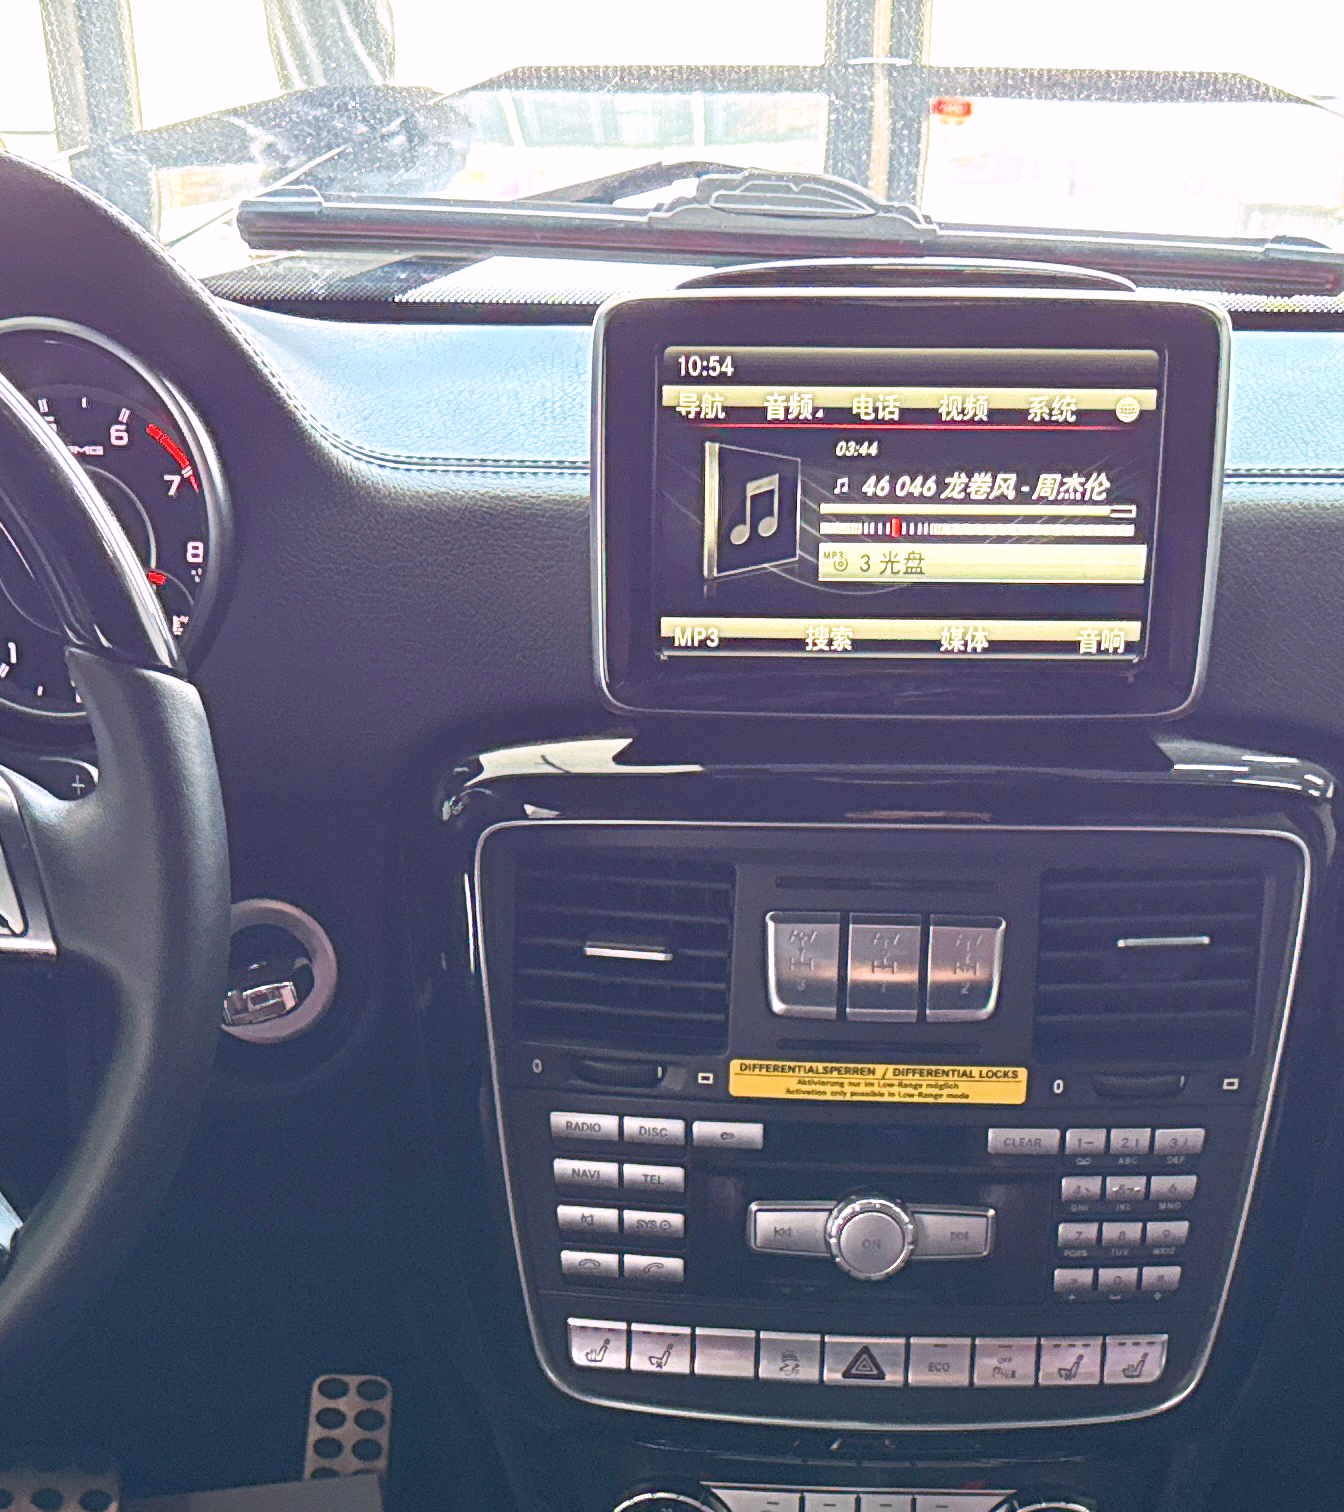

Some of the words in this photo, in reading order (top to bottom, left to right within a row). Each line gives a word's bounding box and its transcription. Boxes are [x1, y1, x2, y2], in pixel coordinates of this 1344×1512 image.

[676, 355, 734, 377] 10:54
[675, 391, 726, 421] 导航
[763, 391, 814, 421] 音频
[851, 392, 901, 422] 电话
[938, 394, 990, 422] 视频
[1027, 395, 1078, 423] 系统
[110, 425, 128, 445] 6
[835, 440, 879, 458] 03:44
[163, 474, 181, 496] 7
[861, 475, 891, 499] 46
[895, 474, 937, 499] 046
[940, 472, 1016, 500] 龙卷风
[1032, 472, 1111, 501] 周杰伦
[186, 542, 204, 563] 8
[823, 550, 844, 560] MP3
[859, 553, 871, 573] 3
[879, 550, 926, 576] 光盘
[674, 628, 720, 648] MP3
[805, 624, 854, 653] 搜索
[940, 626, 990, 653] 媒体
[1077, 628, 1126, 655] 音响
[8, 642, 16, 663] 1
[739, 1062, 876, 1077] DIFFERENTIALSPERREN
[892, 1067, 976, 1079] DIFFERENTIAL
[978, 1069, 1019, 1080] LOCKS
[565, 1120, 602, 1134] RADIO
[638, 1126, 669, 1138] DISC
[1003, 1136, 1043, 1148] CLEAR
[571, 1167, 601, 1180] NAVI
[642, 1173, 664, 1185] TEL
[635, 1218, 657, 1231] SYS
[861, 1238, 881, 1250] ON
[927, 1362, 950, 1373] ECO
